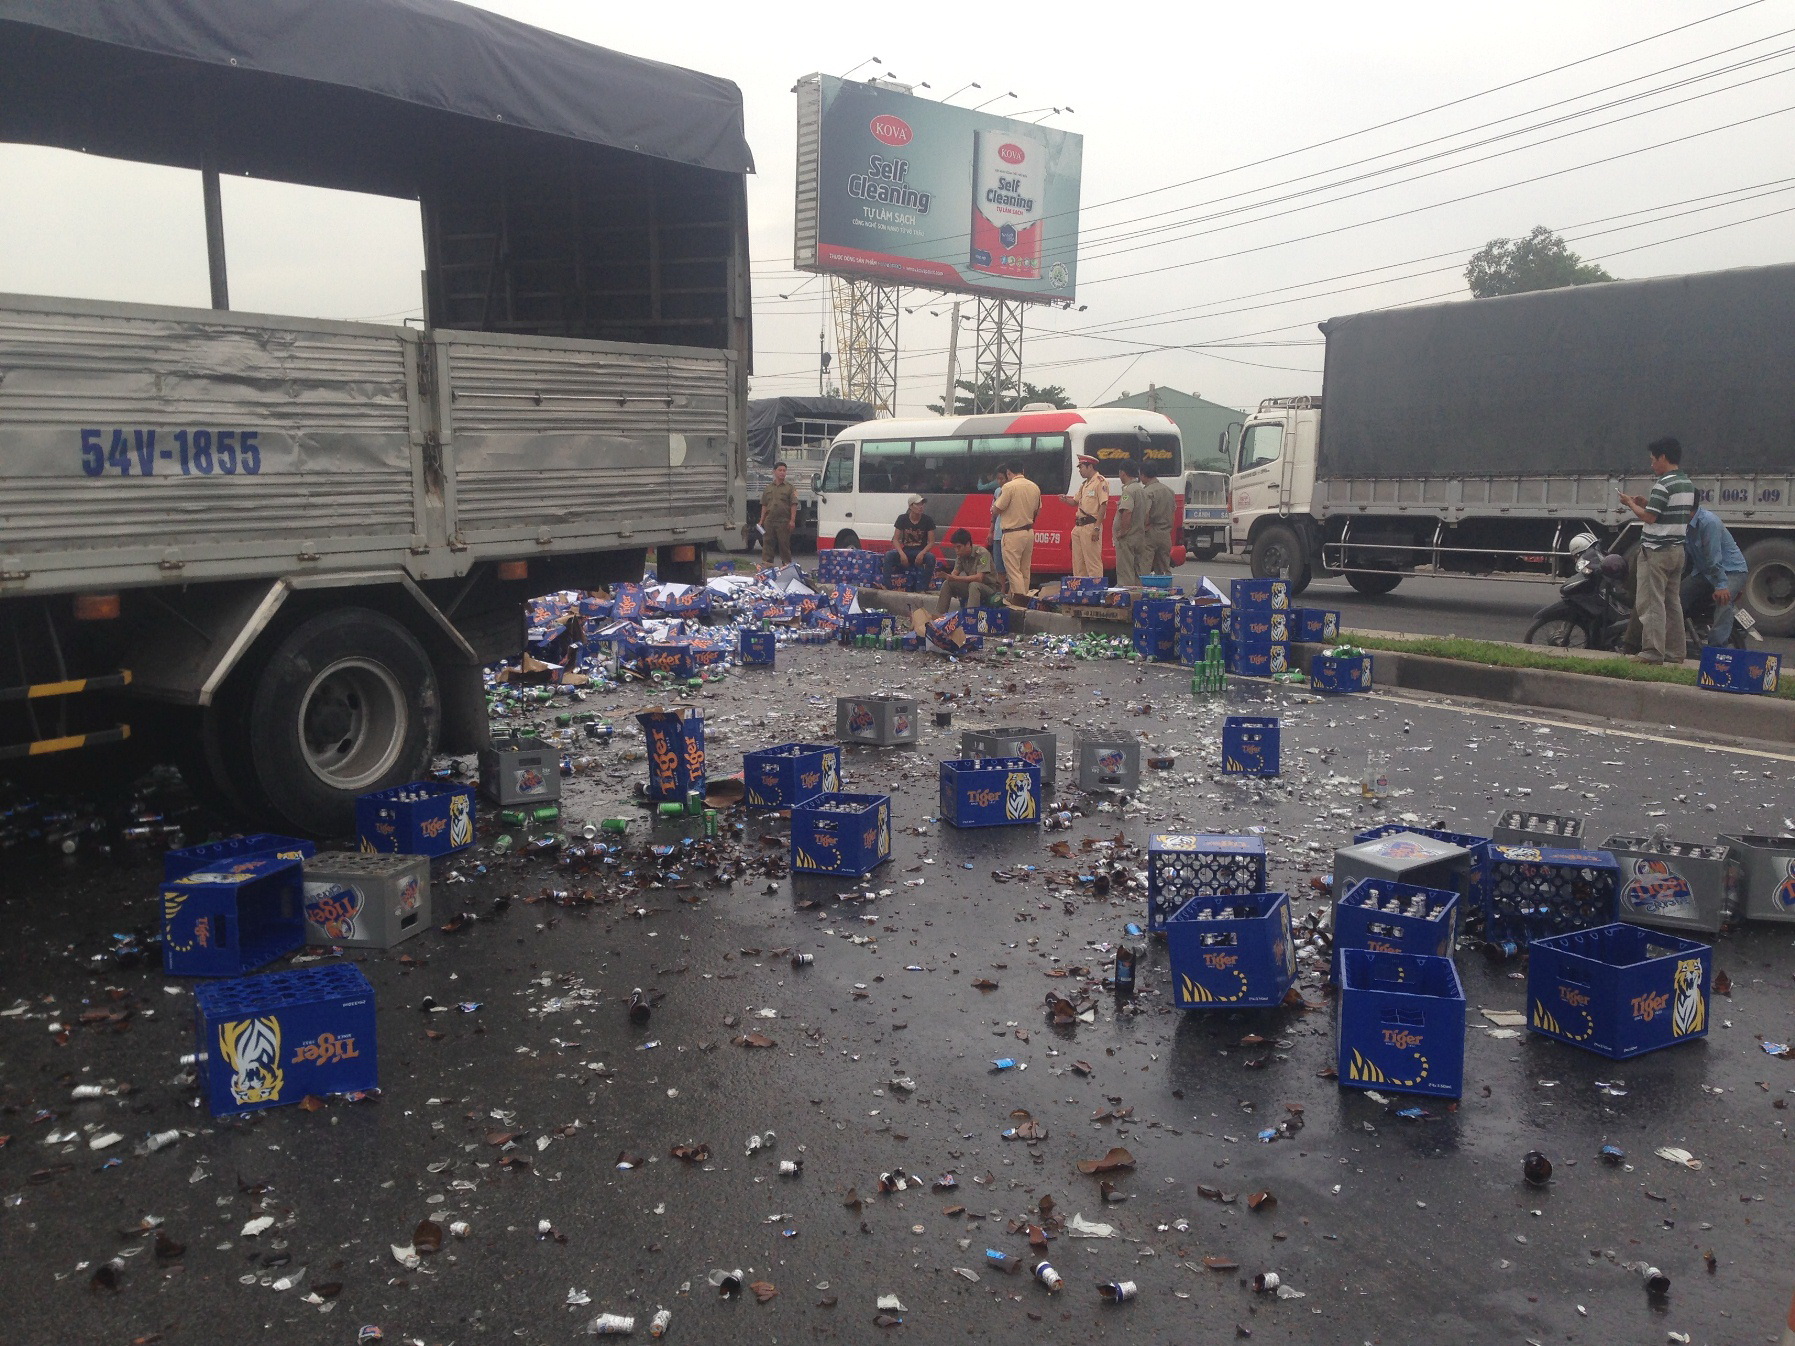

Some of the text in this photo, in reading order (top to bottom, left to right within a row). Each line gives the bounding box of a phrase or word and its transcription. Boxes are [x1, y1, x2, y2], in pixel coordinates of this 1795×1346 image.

[875, 122, 907, 140] KOVA
[1001, 148, 1022, 160] KOVA
[868, 154, 909, 183] Self
[847, 173, 931, 214] Cleaning
[998, 177, 1020, 193] Self
[986, 189, 1033, 212] Cleaning
[876, 207, 893, 222] LÀM
[894, 212, 916, 226] SẠCH
[80, 428, 261, 477] 54V-1855
[1722, 488, 1749, 503] 003
[1250, 591, 1270, 602] Tiger
[1250, 622, 1269, 634] Tiger
[645, 652, 682, 673] Tiger
[1248, 653, 1268, 665] Tiger
[652, 728, 678, 795] Tiger
[683, 736, 705, 782] Tiger
[967, 788, 1002, 808] Tiger
[420, 816, 448, 838] Tiger
[814, 833, 839, 847] Tiger
[307, 897, 359, 922] Tiger
[1203, 952, 1239, 970] Tiger
[1558, 986, 1591, 1007] Tiger
[1631, 991, 1670, 1022] Tiger
[291, 1031, 360, 1067] Tiger
[1381, 1029, 1424, 1050] Tiger
